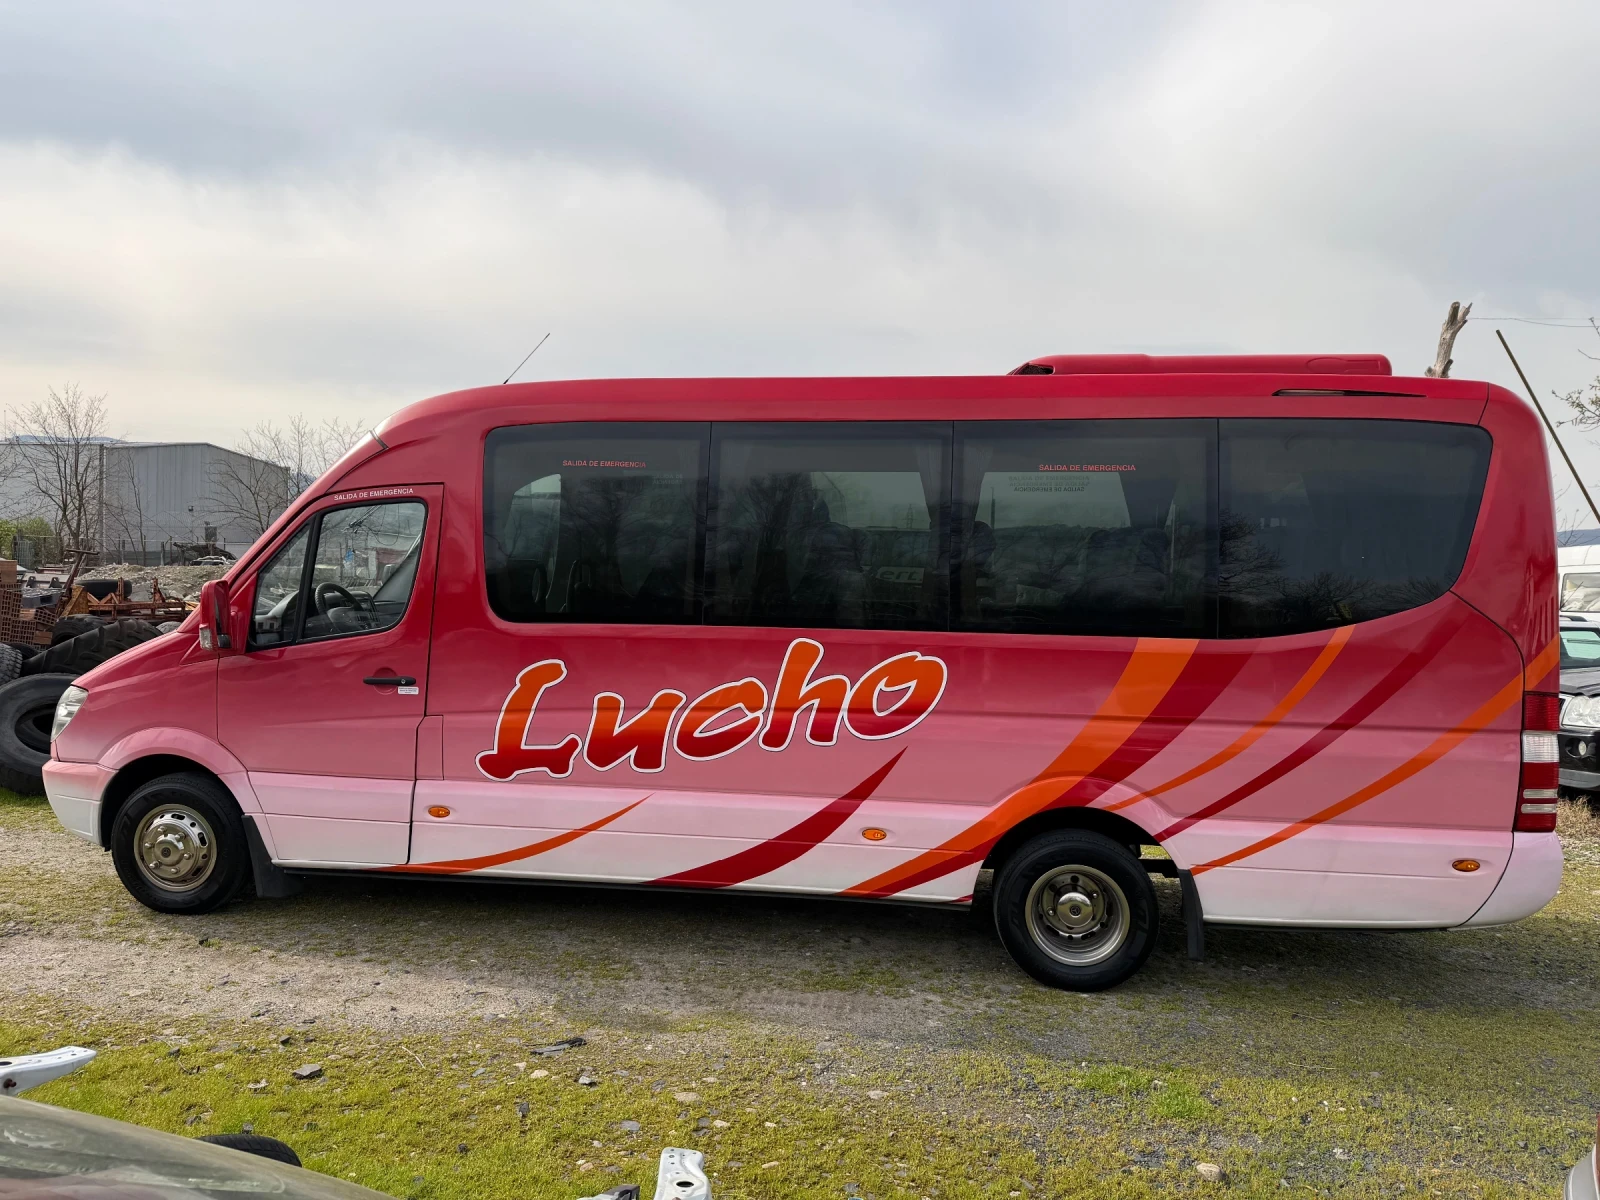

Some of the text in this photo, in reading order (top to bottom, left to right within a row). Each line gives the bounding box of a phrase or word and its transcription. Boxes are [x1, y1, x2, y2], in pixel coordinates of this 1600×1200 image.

[600, 460, 646, 468] EMERGENCIA
[1083, 464, 1136, 472] EMERGENCIA
[334, 493, 357, 501] SALIDA
[369, 488, 414, 497] EMERGENCIA
[475, 637, 948, 782] Lucho
